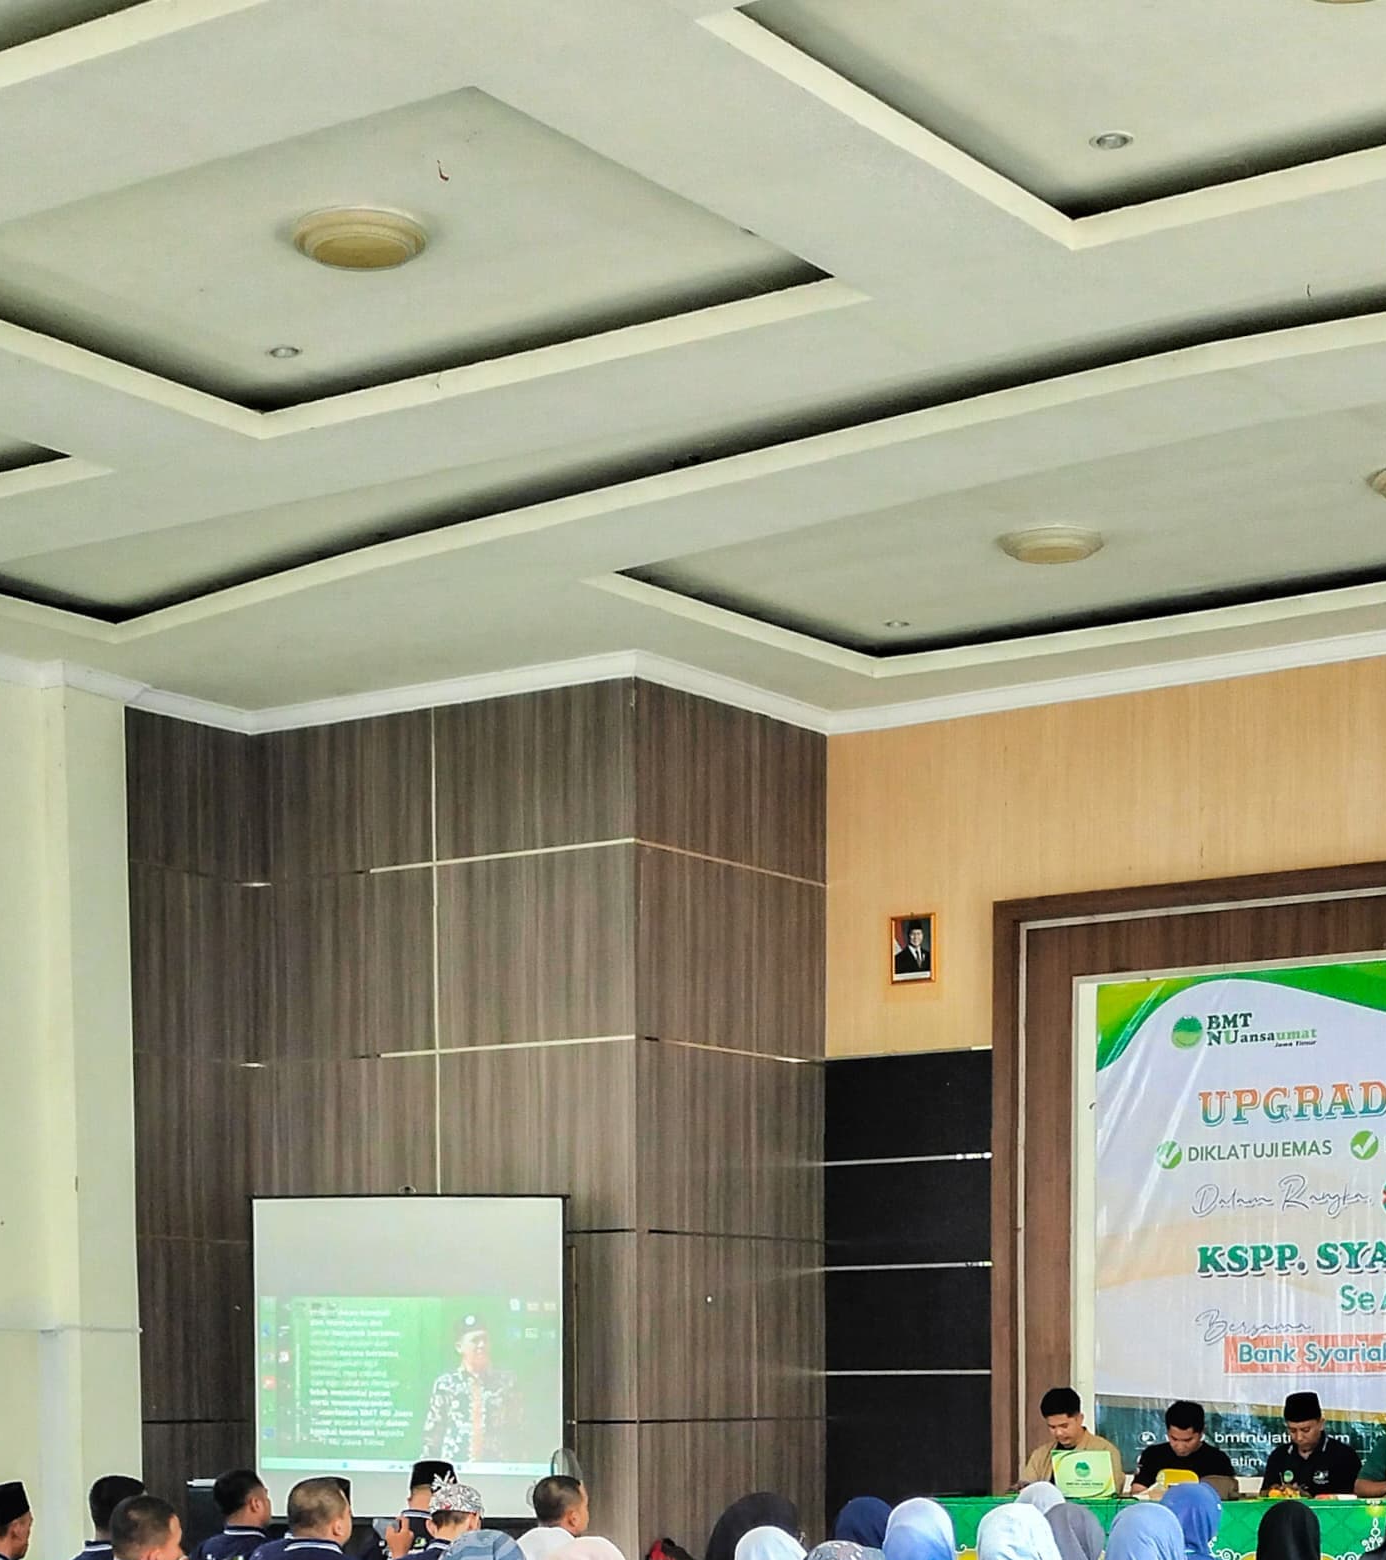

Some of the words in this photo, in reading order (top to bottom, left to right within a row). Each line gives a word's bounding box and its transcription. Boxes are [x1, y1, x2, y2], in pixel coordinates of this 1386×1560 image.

[1206, 1012, 1253, 1030] BMT
[1187, 1141, 1252, 1163] DIKLAT
[1281, 1138, 1333, 1158] EMAS
[1196, 1244, 1309, 1277] KSPP.
[1339, 1283, 1375, 1313] Se
[1237, 1342, 1297, 1364] Bank
